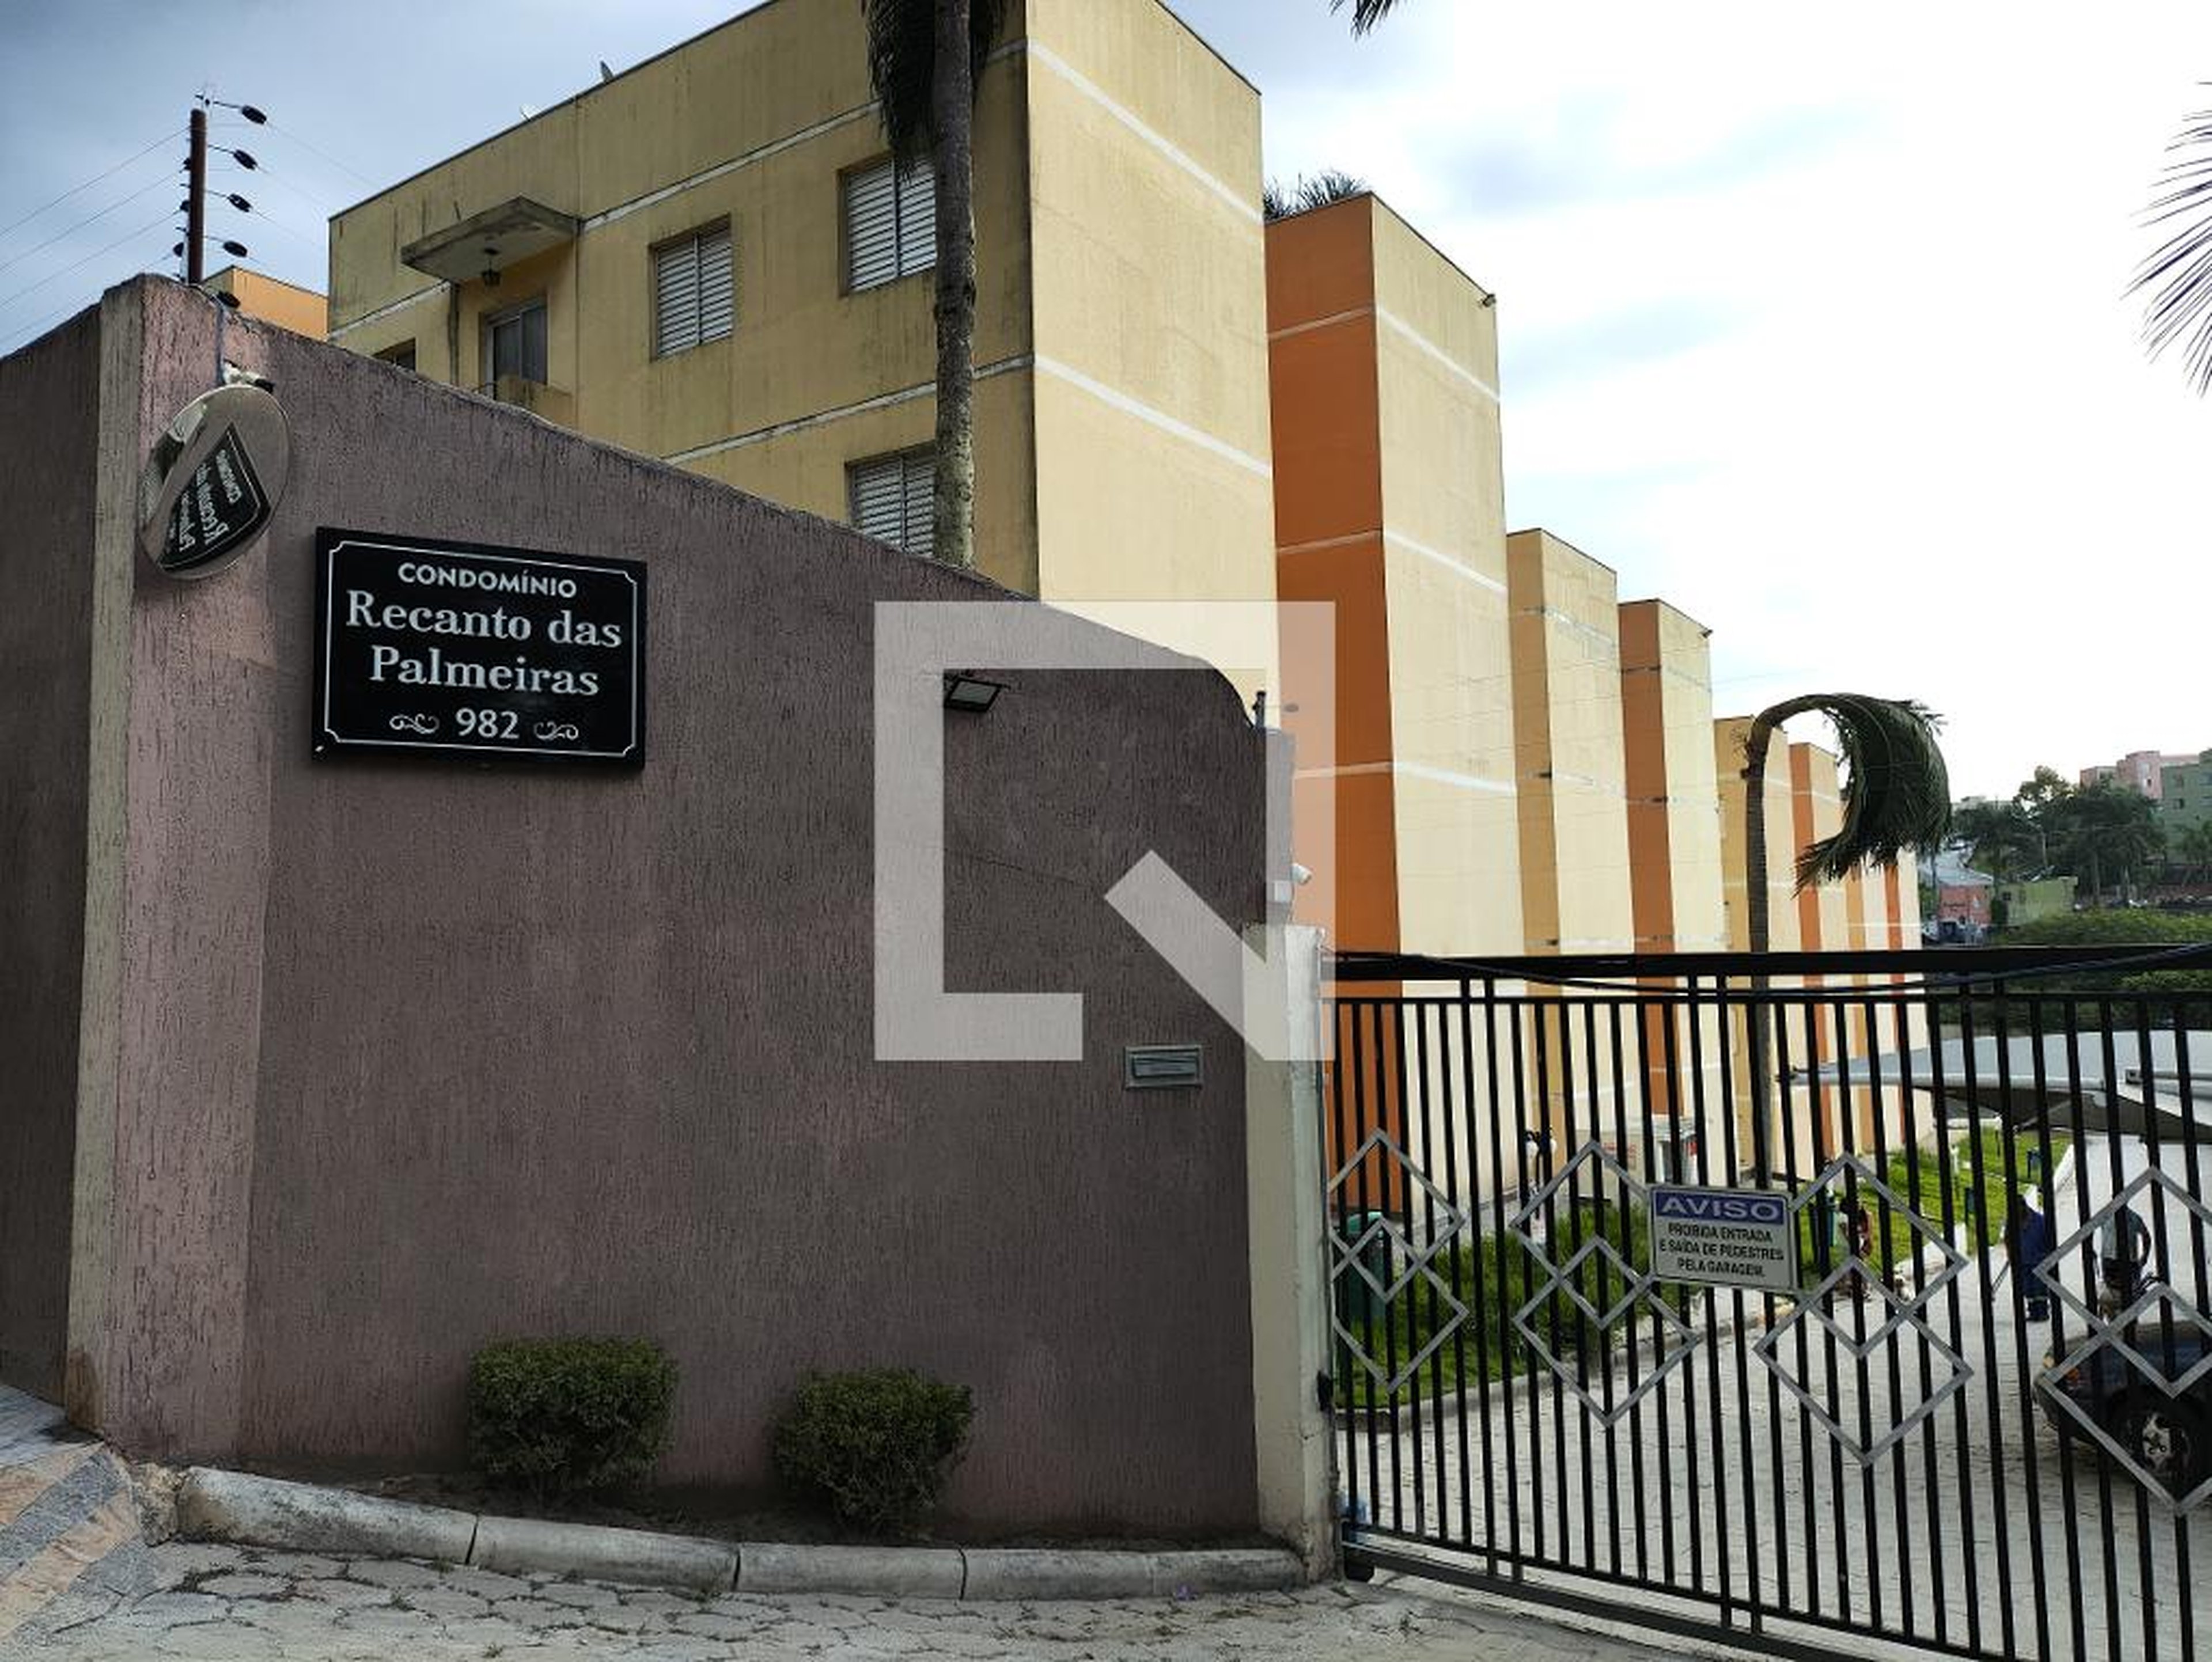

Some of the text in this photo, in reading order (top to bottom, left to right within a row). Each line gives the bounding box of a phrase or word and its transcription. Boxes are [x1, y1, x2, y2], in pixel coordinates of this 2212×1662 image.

[397, 562, 577, 598] CONDOMÍNIO
[345, 589, 622, 648] Recanto das
[369, 644, 600, 696] Palmeiras
[455, 708, 520, 739] 982
[1661, 1197, 1779, 1220] AVISO
[1660, 1239, 1666, 1251] E
[1703, 1242, 1717, 1256] DE
[1721, 1226, 1772, 1243] ENTRADA
